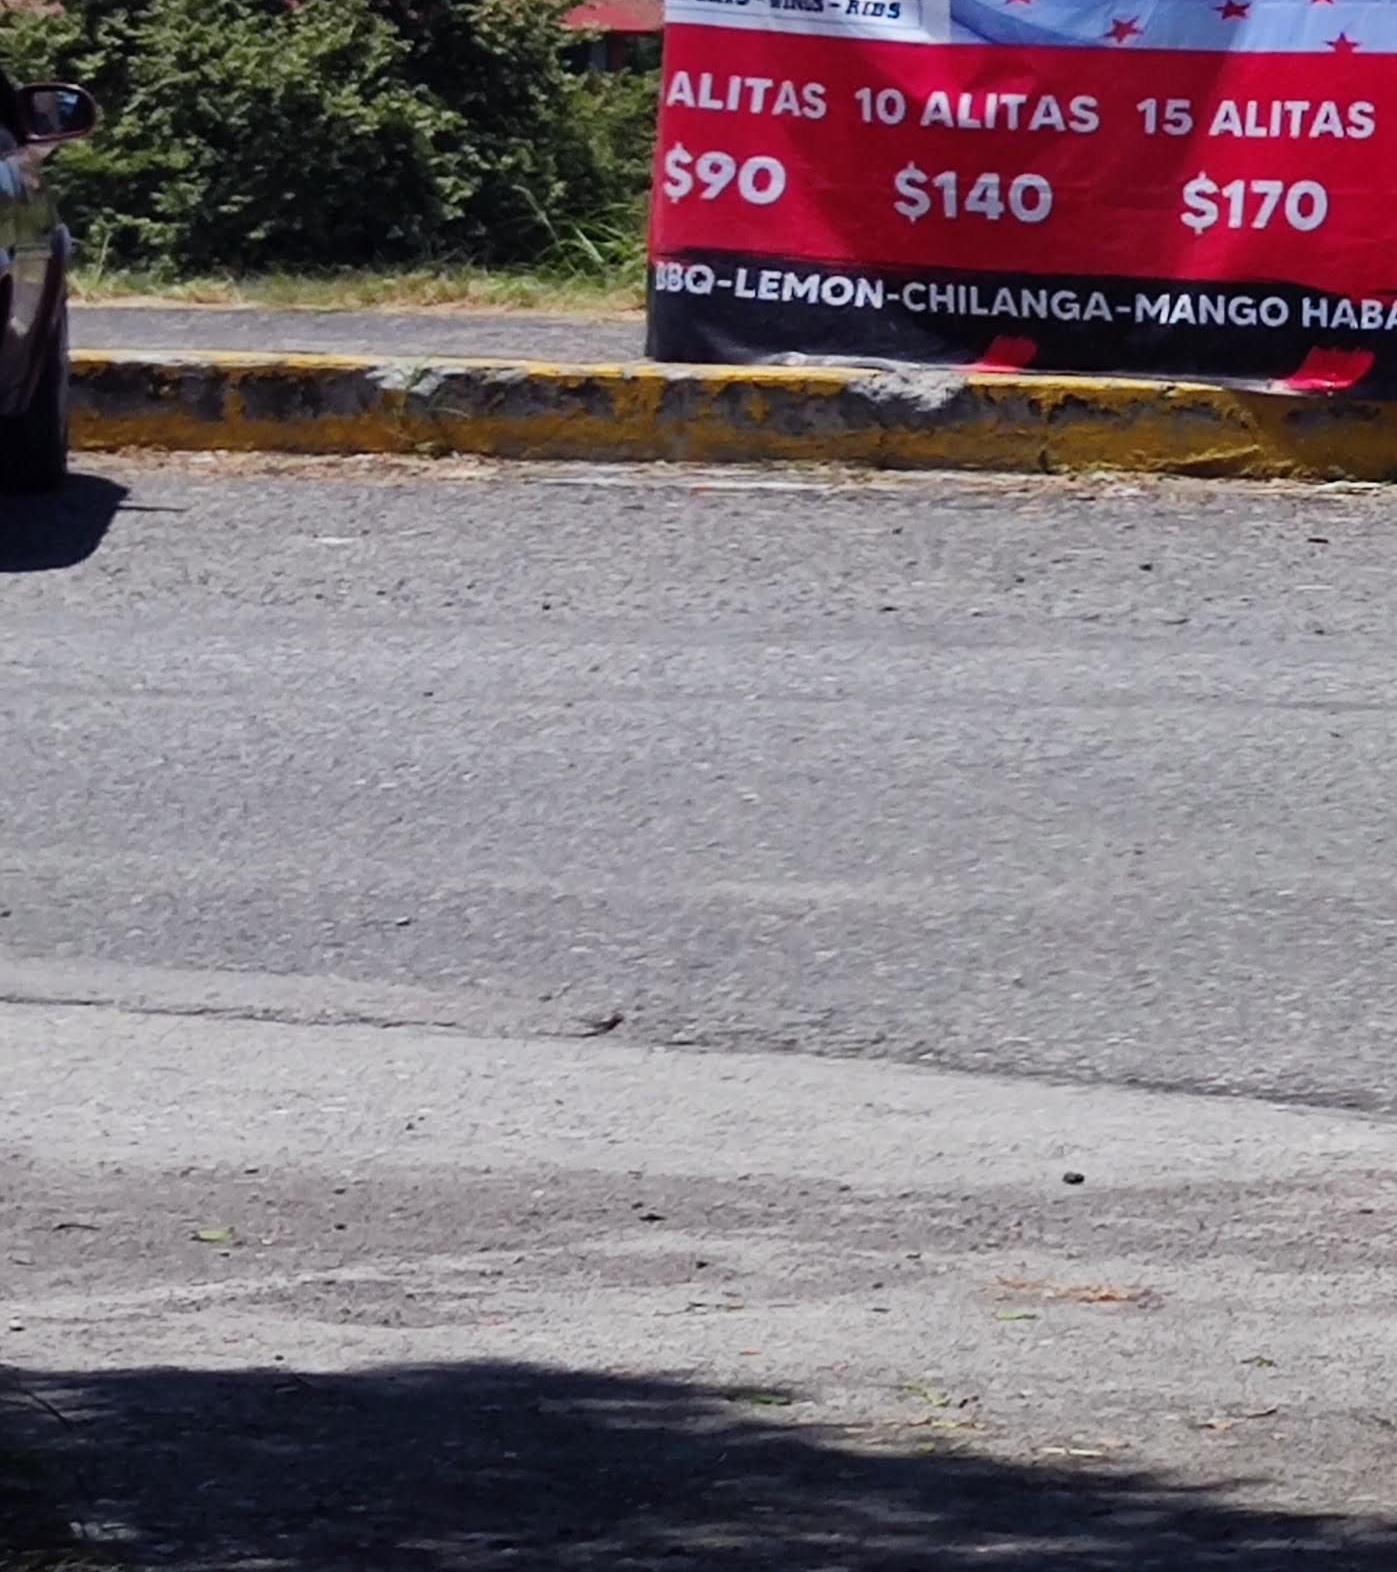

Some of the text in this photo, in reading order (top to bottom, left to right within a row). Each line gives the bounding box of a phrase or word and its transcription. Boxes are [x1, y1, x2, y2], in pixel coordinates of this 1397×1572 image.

[845, 0, 901, 19] RIBS
[666, 71, 828, 120] ALITAS
[855, 87, 905, 124] 10
[920, 91, 1100, 133] ALITAS
[1137, 97, 1194, 136] 15
[1208, 100, 1376, 140] ALITAS
[662, 142, 787, 205] $90
[893, 162, 1053, 224] $140
[1180, 172, 1328, 236] $170
